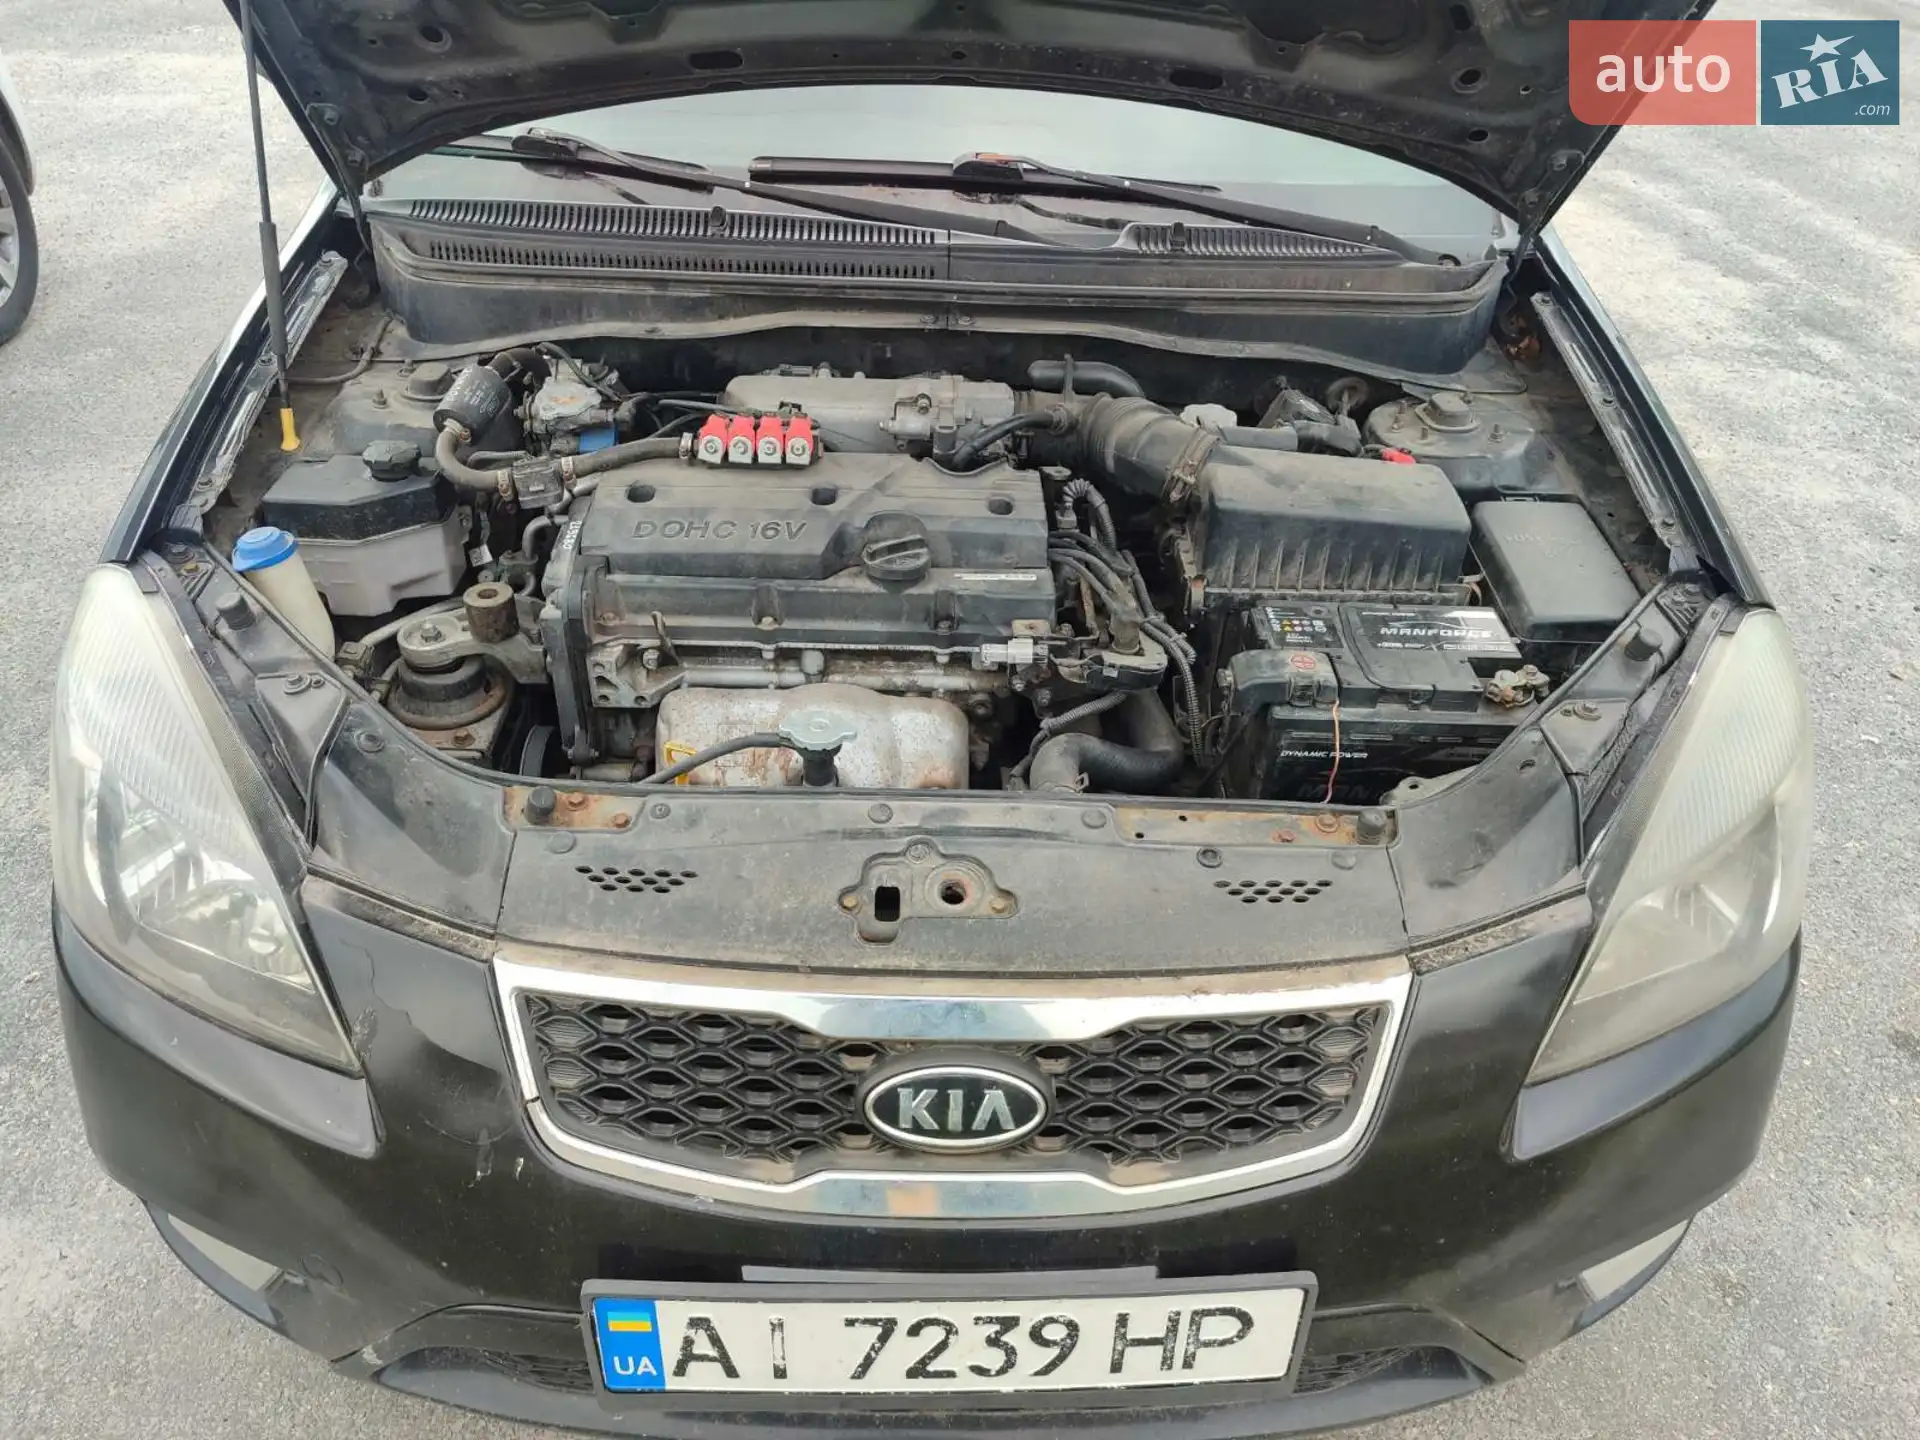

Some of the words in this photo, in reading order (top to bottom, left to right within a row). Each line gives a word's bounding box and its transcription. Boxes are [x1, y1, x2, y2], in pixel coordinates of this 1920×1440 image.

[631, 519, 738, 541] DOHC
[749, 520, 807, 542] 16V
[1280, 749, 1329, 759] DYNAMIC
[1329, 750, 1369, 760] POWER
[897, 1087, 1016, 1133] KIA
[672, 1315, 788, 1381] AI
[843, 1313, 1082, 1380] 7239
[1108, 1305, 1256, 1374] HP
[614, 1356, 658, 1378] UA
